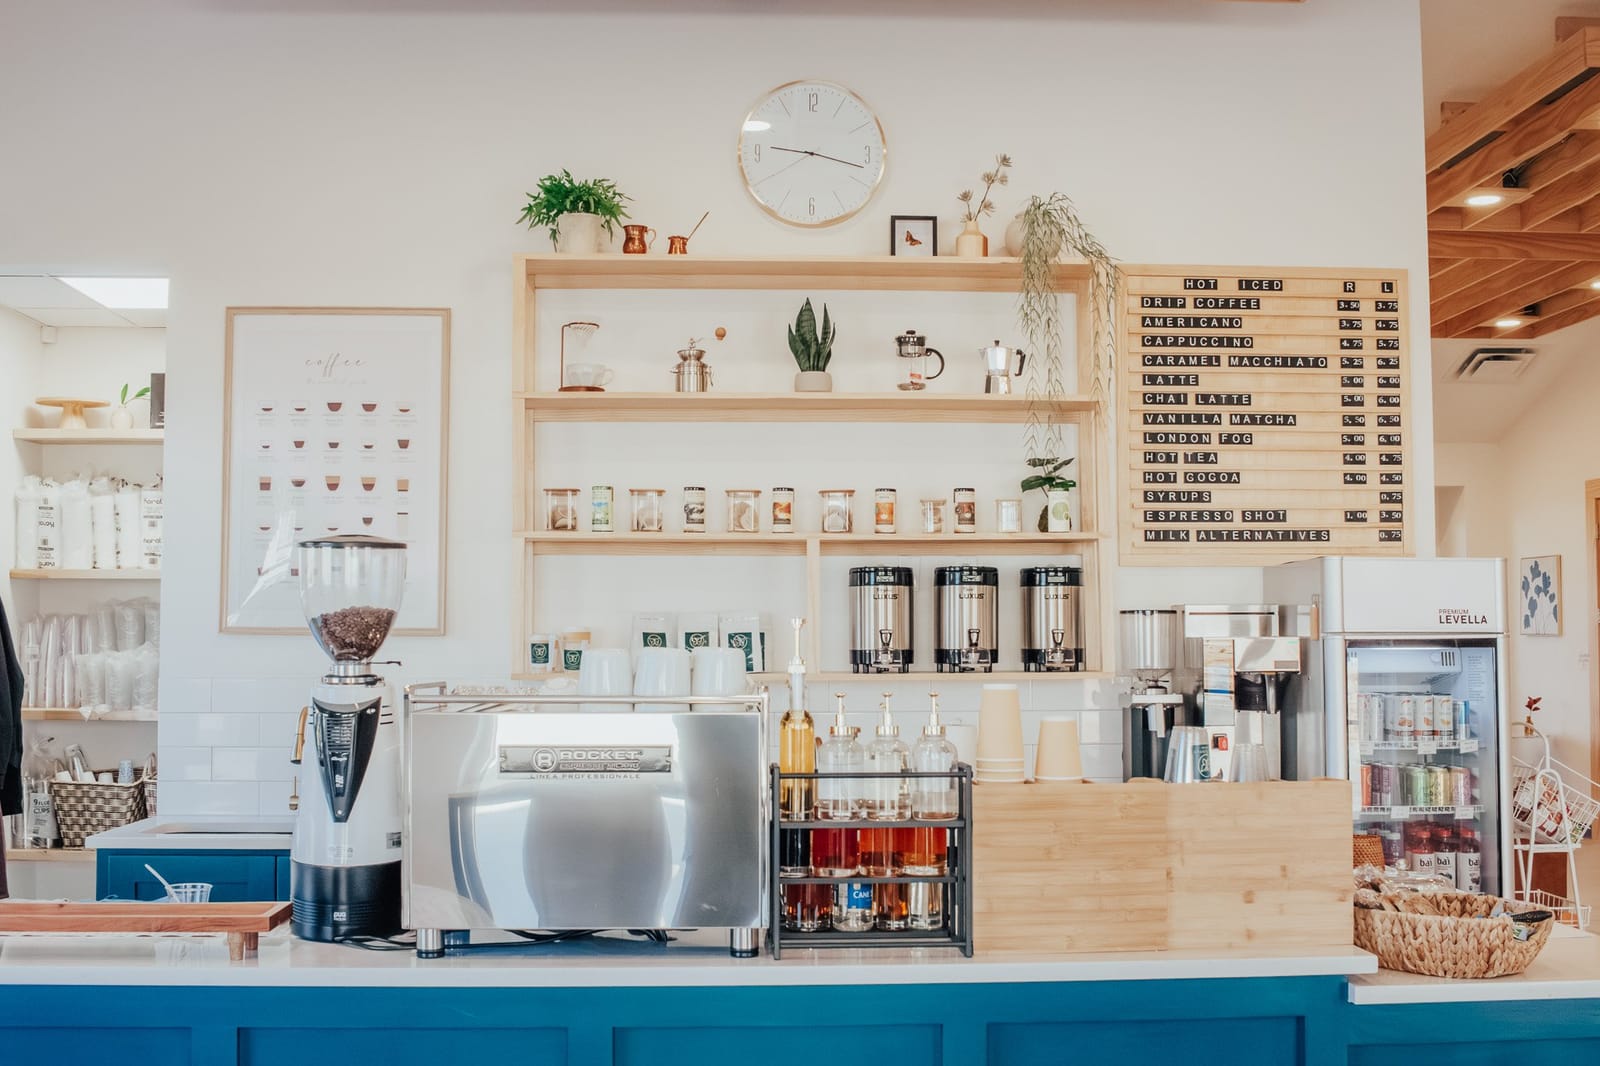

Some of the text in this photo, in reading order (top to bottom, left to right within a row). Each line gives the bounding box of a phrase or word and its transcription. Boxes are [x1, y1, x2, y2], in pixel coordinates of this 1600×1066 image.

[808, 93, 818, 112] 12
[754, 143, 761, 163] 9
[864, 145, 871, 164] 3
[808, 197, 815, 216] 6
[1186, 280, 1391, 292] HOT ICED R L
[1143, 298, 1184, 308] DRIP
[1196, 299, 1258, 309] COFFEE
[1144, 318, 1241, 328] AMERICANO
[1144, 337, 1252, 347] CAPPUCCINO
[1144, 356, 1219, 366] CARAMEL
[1230, 357, 1326, 367] MACCHIATO
[1145, 376, 1197, 385] LATTE
[1145, 394, 1185, 404] CHAI
[1198, 395, 1249, 404] LATTE
[1146, 415, 1221, 424] VANILLA
[1146, 434, 1210, 444] LONDON
[1221, 434, 1251, 444] FOG
[1145, 453, 1177, 463] HOT
[1185, 453, 1217, 463] TEA
[1145, 473, 1175, 482] HOT
[1146, 492, 1210, 502] SYRUPS
[1146, 512, 1233, 521] ESPRESSO
[1244, 512, 1284, 521] SHOT
[1146, 531, 1188, 540] MILK
[1198, 531, 1329, 541] ALTERNATIVES
[1439, 615, 1488, 624] LEVELLA
[560, 750, 639, 760] ROCKET
